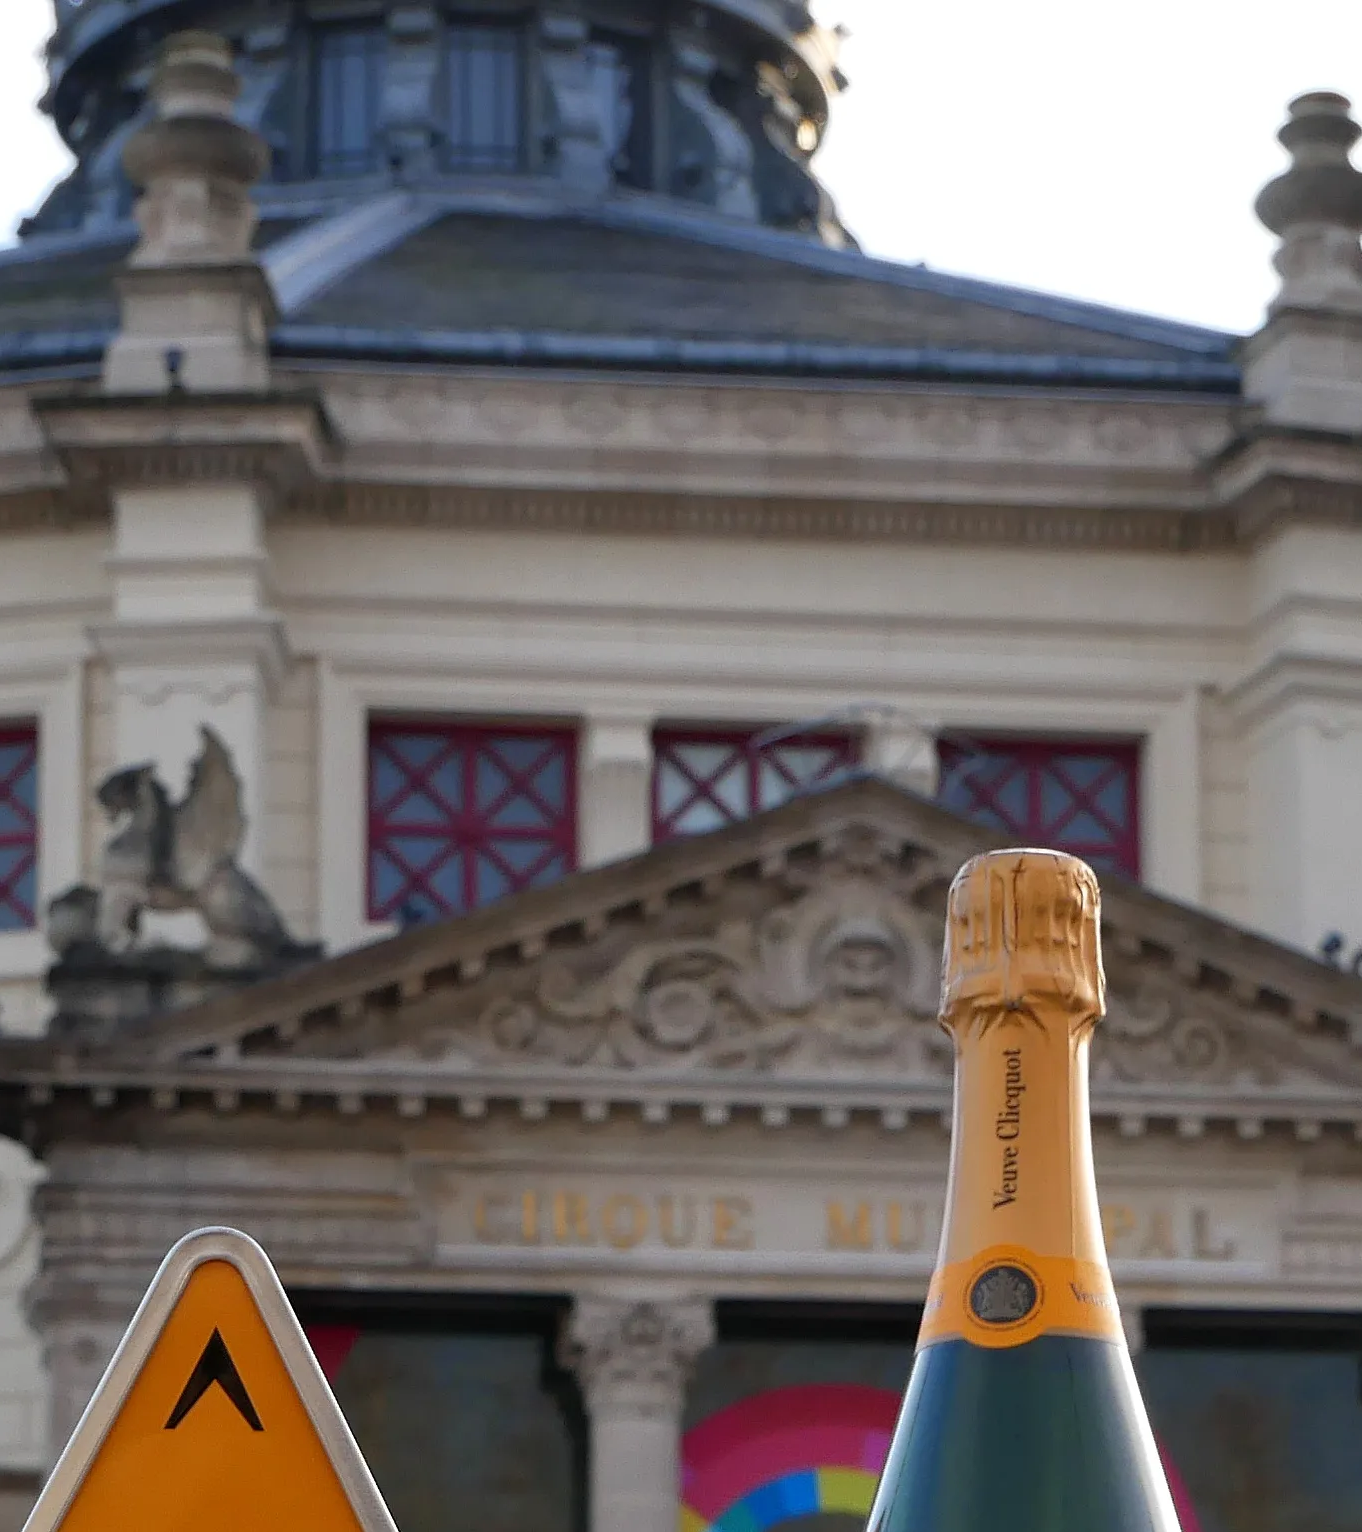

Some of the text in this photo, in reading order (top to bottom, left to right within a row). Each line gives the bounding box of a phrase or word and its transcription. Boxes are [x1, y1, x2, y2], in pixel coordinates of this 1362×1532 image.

[993, 1047, 1025, 1210] Veuve Clicquot
[472, 1188, 756, 1252] CIRQUE
